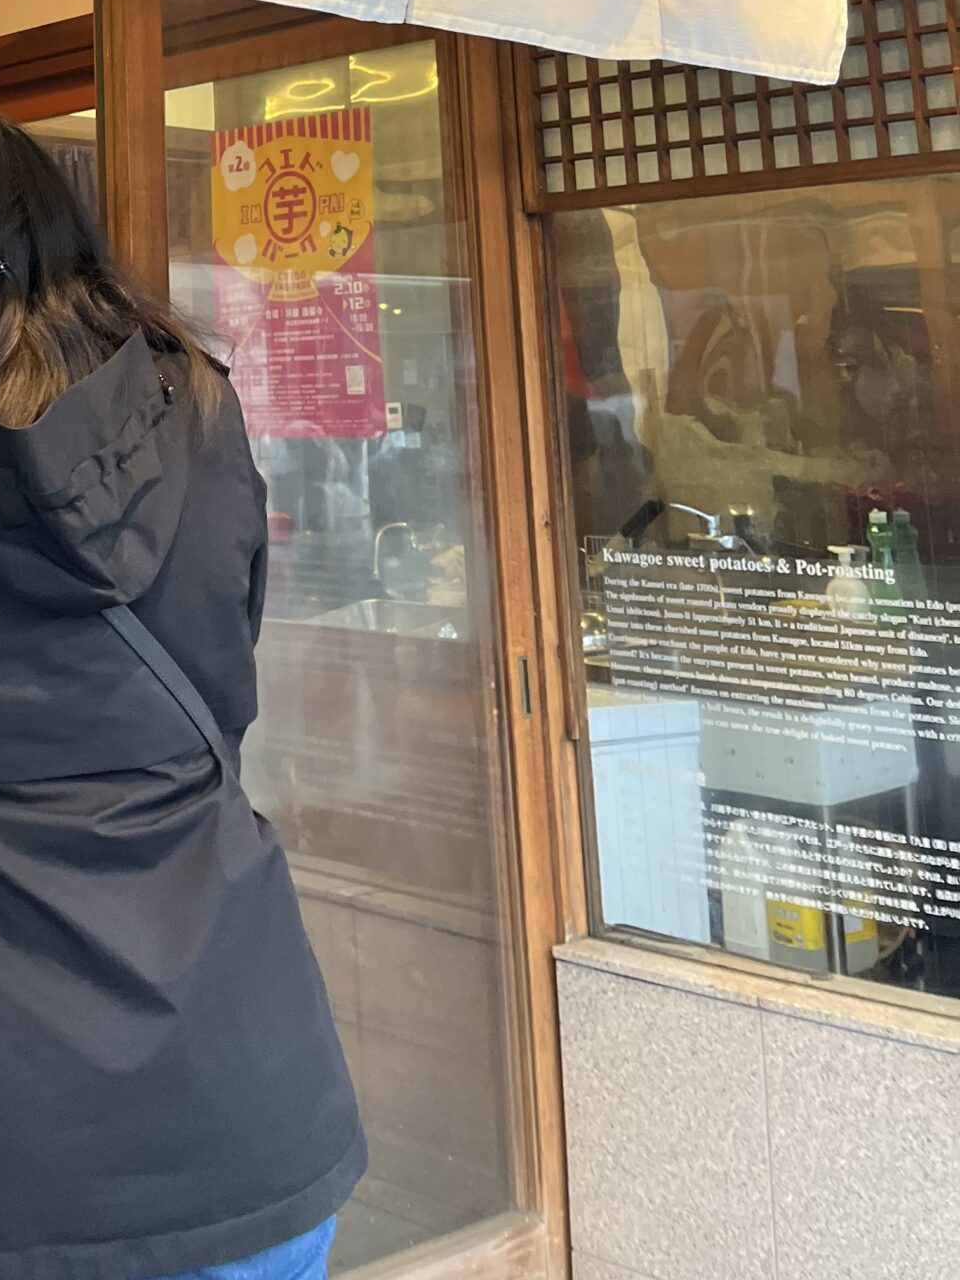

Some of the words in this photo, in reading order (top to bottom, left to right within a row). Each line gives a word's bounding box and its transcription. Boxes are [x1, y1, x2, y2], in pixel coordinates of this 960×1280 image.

[334, 281, 363, 296] 2.10
[348, 297, 364, 310] 12
[602, 548, 664, 569] Kawagoe
[666, 554, 706, 569] sweet
[709, 557, 772, 573] potatoes
[776, 558, 791, 574] &
[795, 559, 896, 585] Pot-roasting
